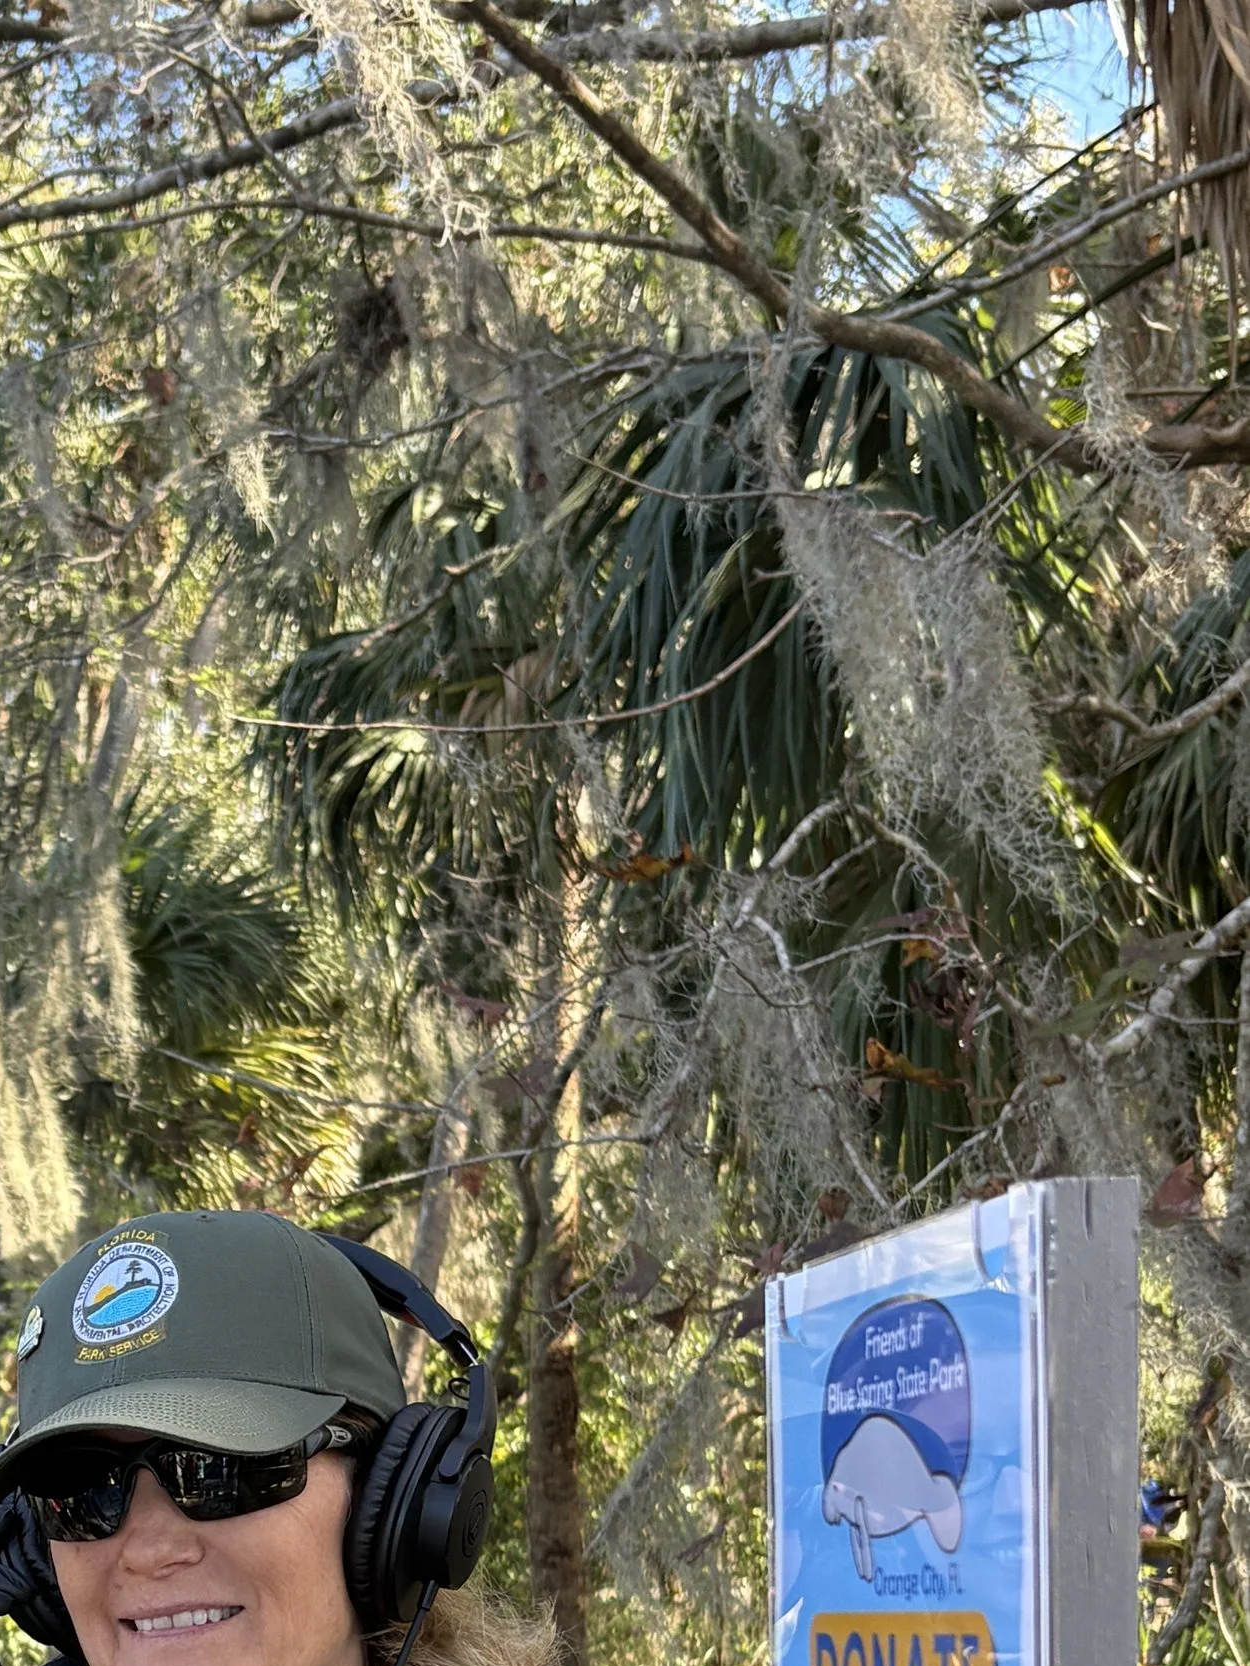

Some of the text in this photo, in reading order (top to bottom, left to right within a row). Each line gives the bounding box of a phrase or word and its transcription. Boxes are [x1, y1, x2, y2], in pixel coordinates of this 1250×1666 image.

[98, 1229, 155, 1256] FLORIDA
[78, 1329, 160, 1360] PARK SERVICE
[865, 1317, 924, 1360] Friends of
[827, 1353, 967, 1415] Blue Spring State Park
[874, 1565, 918, 1601] Orange
